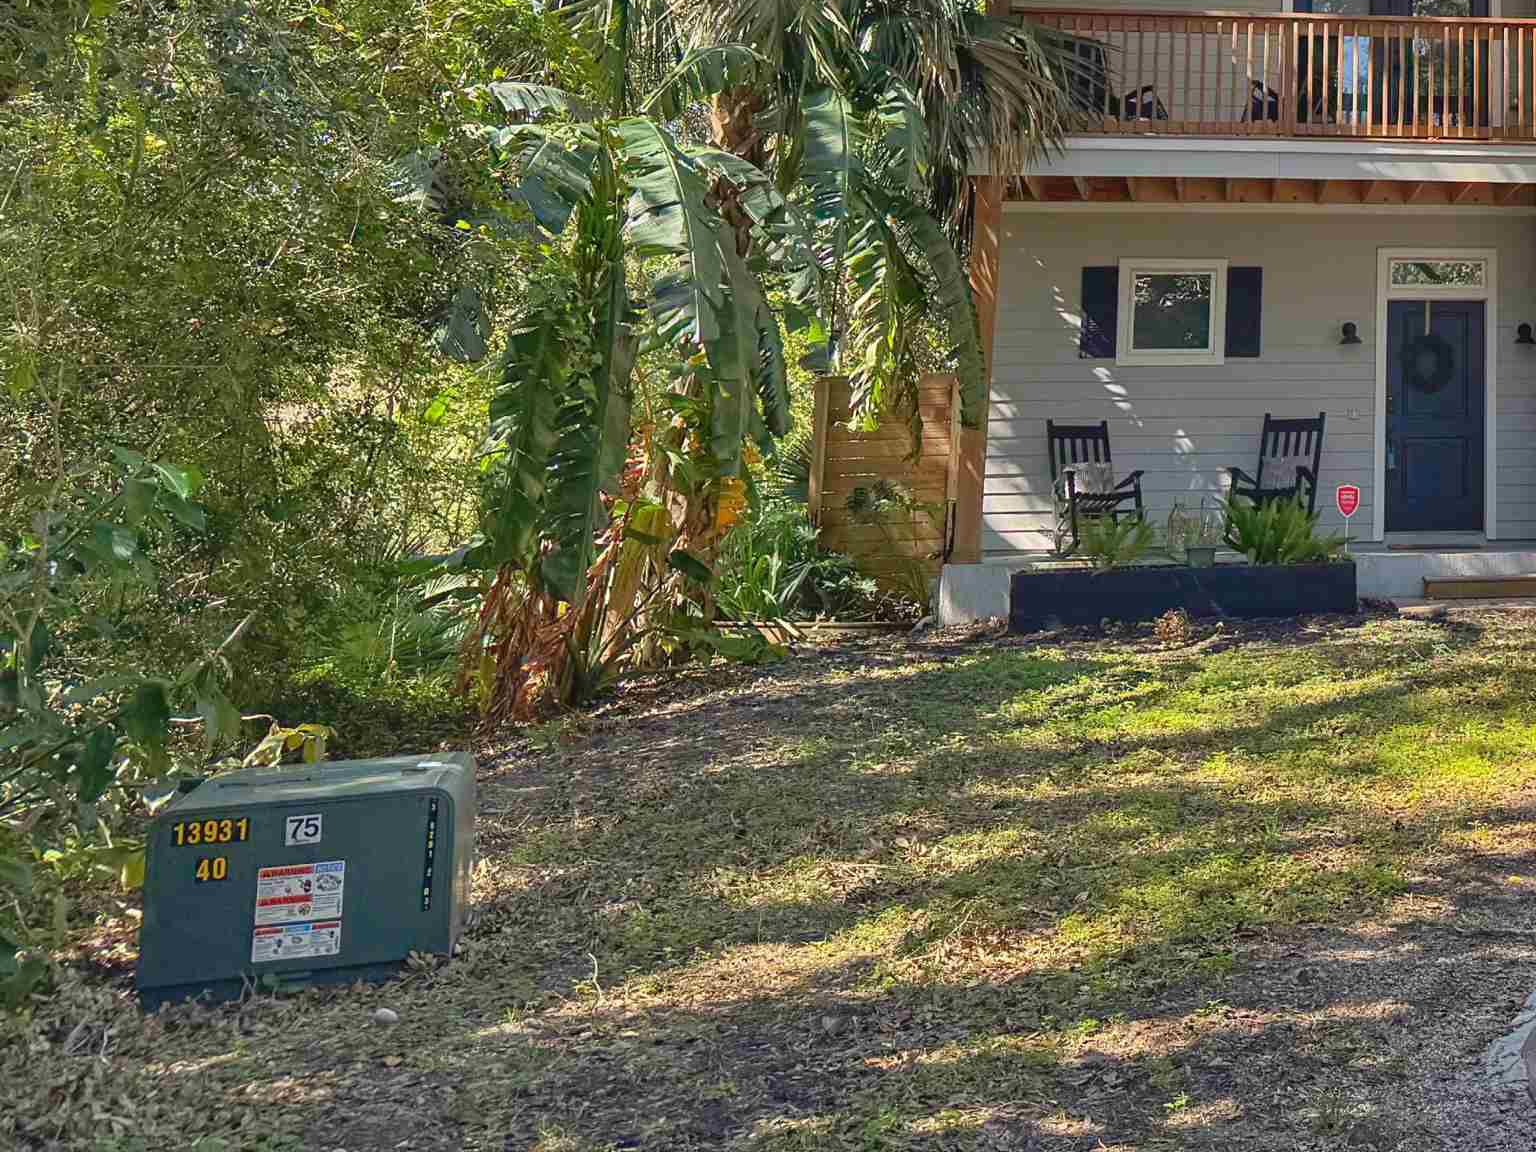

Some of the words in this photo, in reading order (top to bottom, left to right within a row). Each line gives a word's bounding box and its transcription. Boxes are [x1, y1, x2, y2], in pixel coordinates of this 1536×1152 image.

[174, 818, 248, 845] 13931
[289, 817, 319, 840] 75
[196, 857, 226, 881] 40
